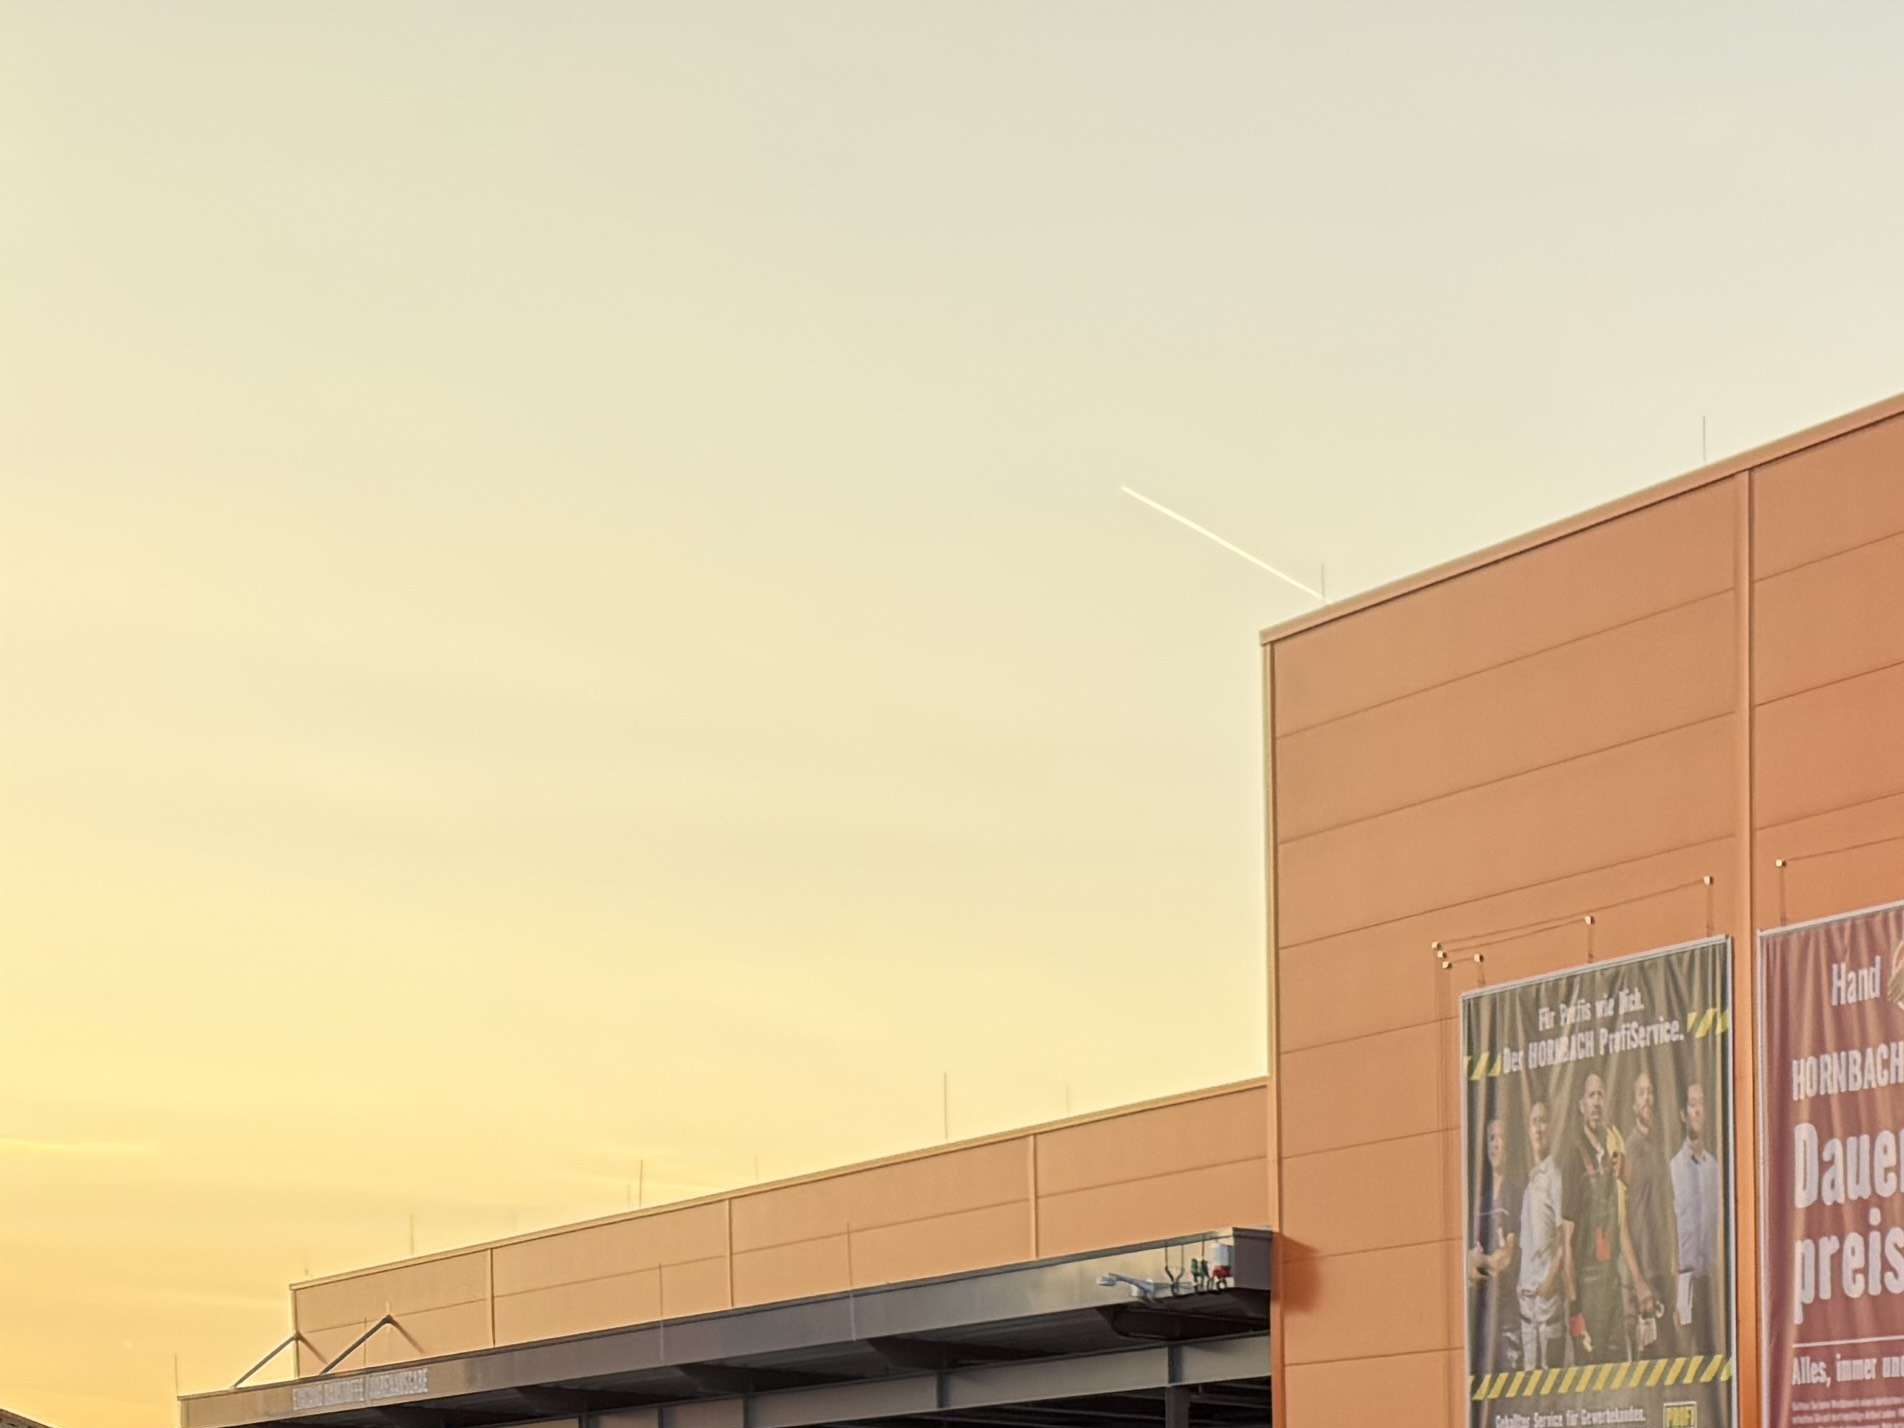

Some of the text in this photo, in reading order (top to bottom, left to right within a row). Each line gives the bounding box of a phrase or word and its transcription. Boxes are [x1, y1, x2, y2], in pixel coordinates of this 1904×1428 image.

[1831, 955, 1881, 1006] Hand
[1538, 1006, 1555, 1032] Für
[1559, 998, 1592, 1026] Profis
[1595, 994, 1615, 1019] wie
[1503, 1016, 1685, 1074] Der HORNBACH ProfiService.
[1792, 1040, 1904, 1101] HORNBACH
[1792, 1355, 1831, 1388] Alles,
[1835, 1353, 1877, 1383] immer
[1566, 1408, 1579, 1427] für
